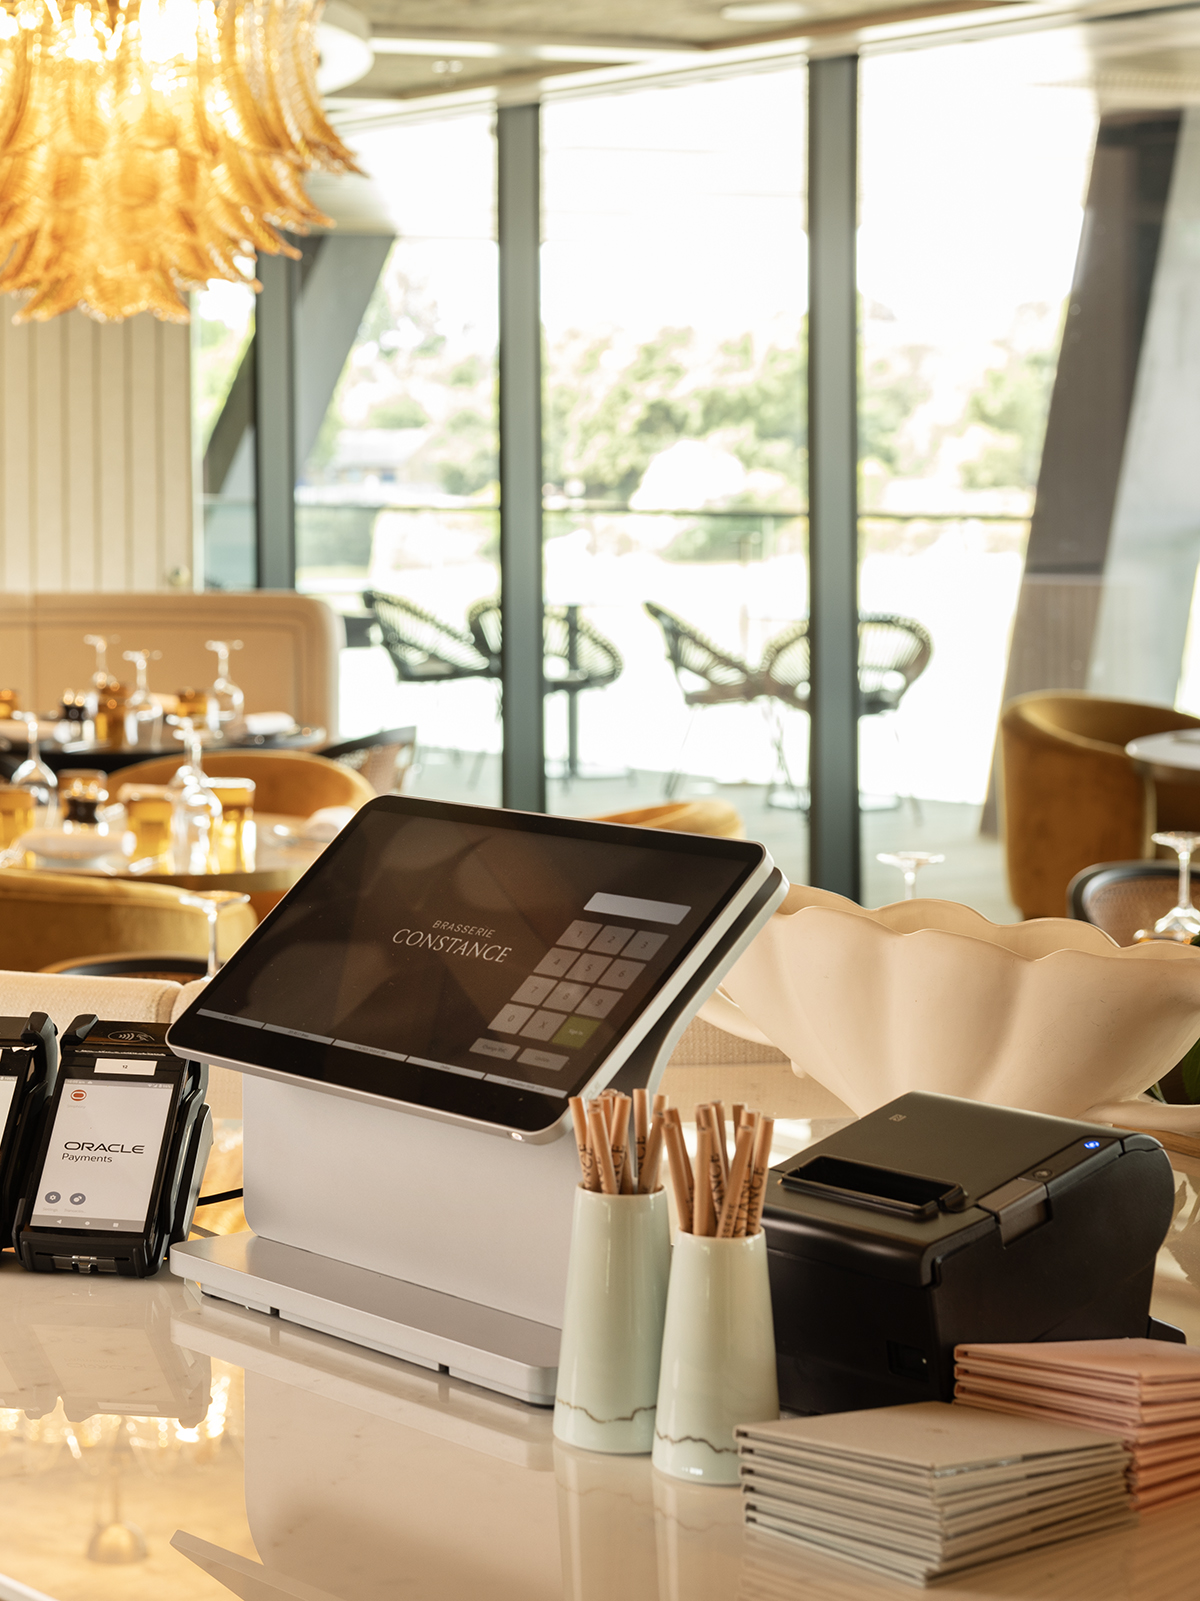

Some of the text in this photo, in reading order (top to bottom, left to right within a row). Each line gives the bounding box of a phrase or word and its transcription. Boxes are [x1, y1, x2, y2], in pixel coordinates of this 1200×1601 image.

[432, 919, 496, 939] BRASSERIE
[576, 930, 583, 938] 1
[607, 935, 616, 944] 2
[392, 928, 513, 963] CONSTANCE
[640, 941, 649, 949] 3
[553, 957, 562, 966] 4
[585, 963, 594, 972] 5
[618, 969, 627, 978] 6
[531, 986, 539, 994] 7
[562, 992, 571, 1001] 8
[595, 998, 604, 1007] 9
[64, 1141, 145, 1154] ORACLE
[61, 1152, 113, 1163] Payments
